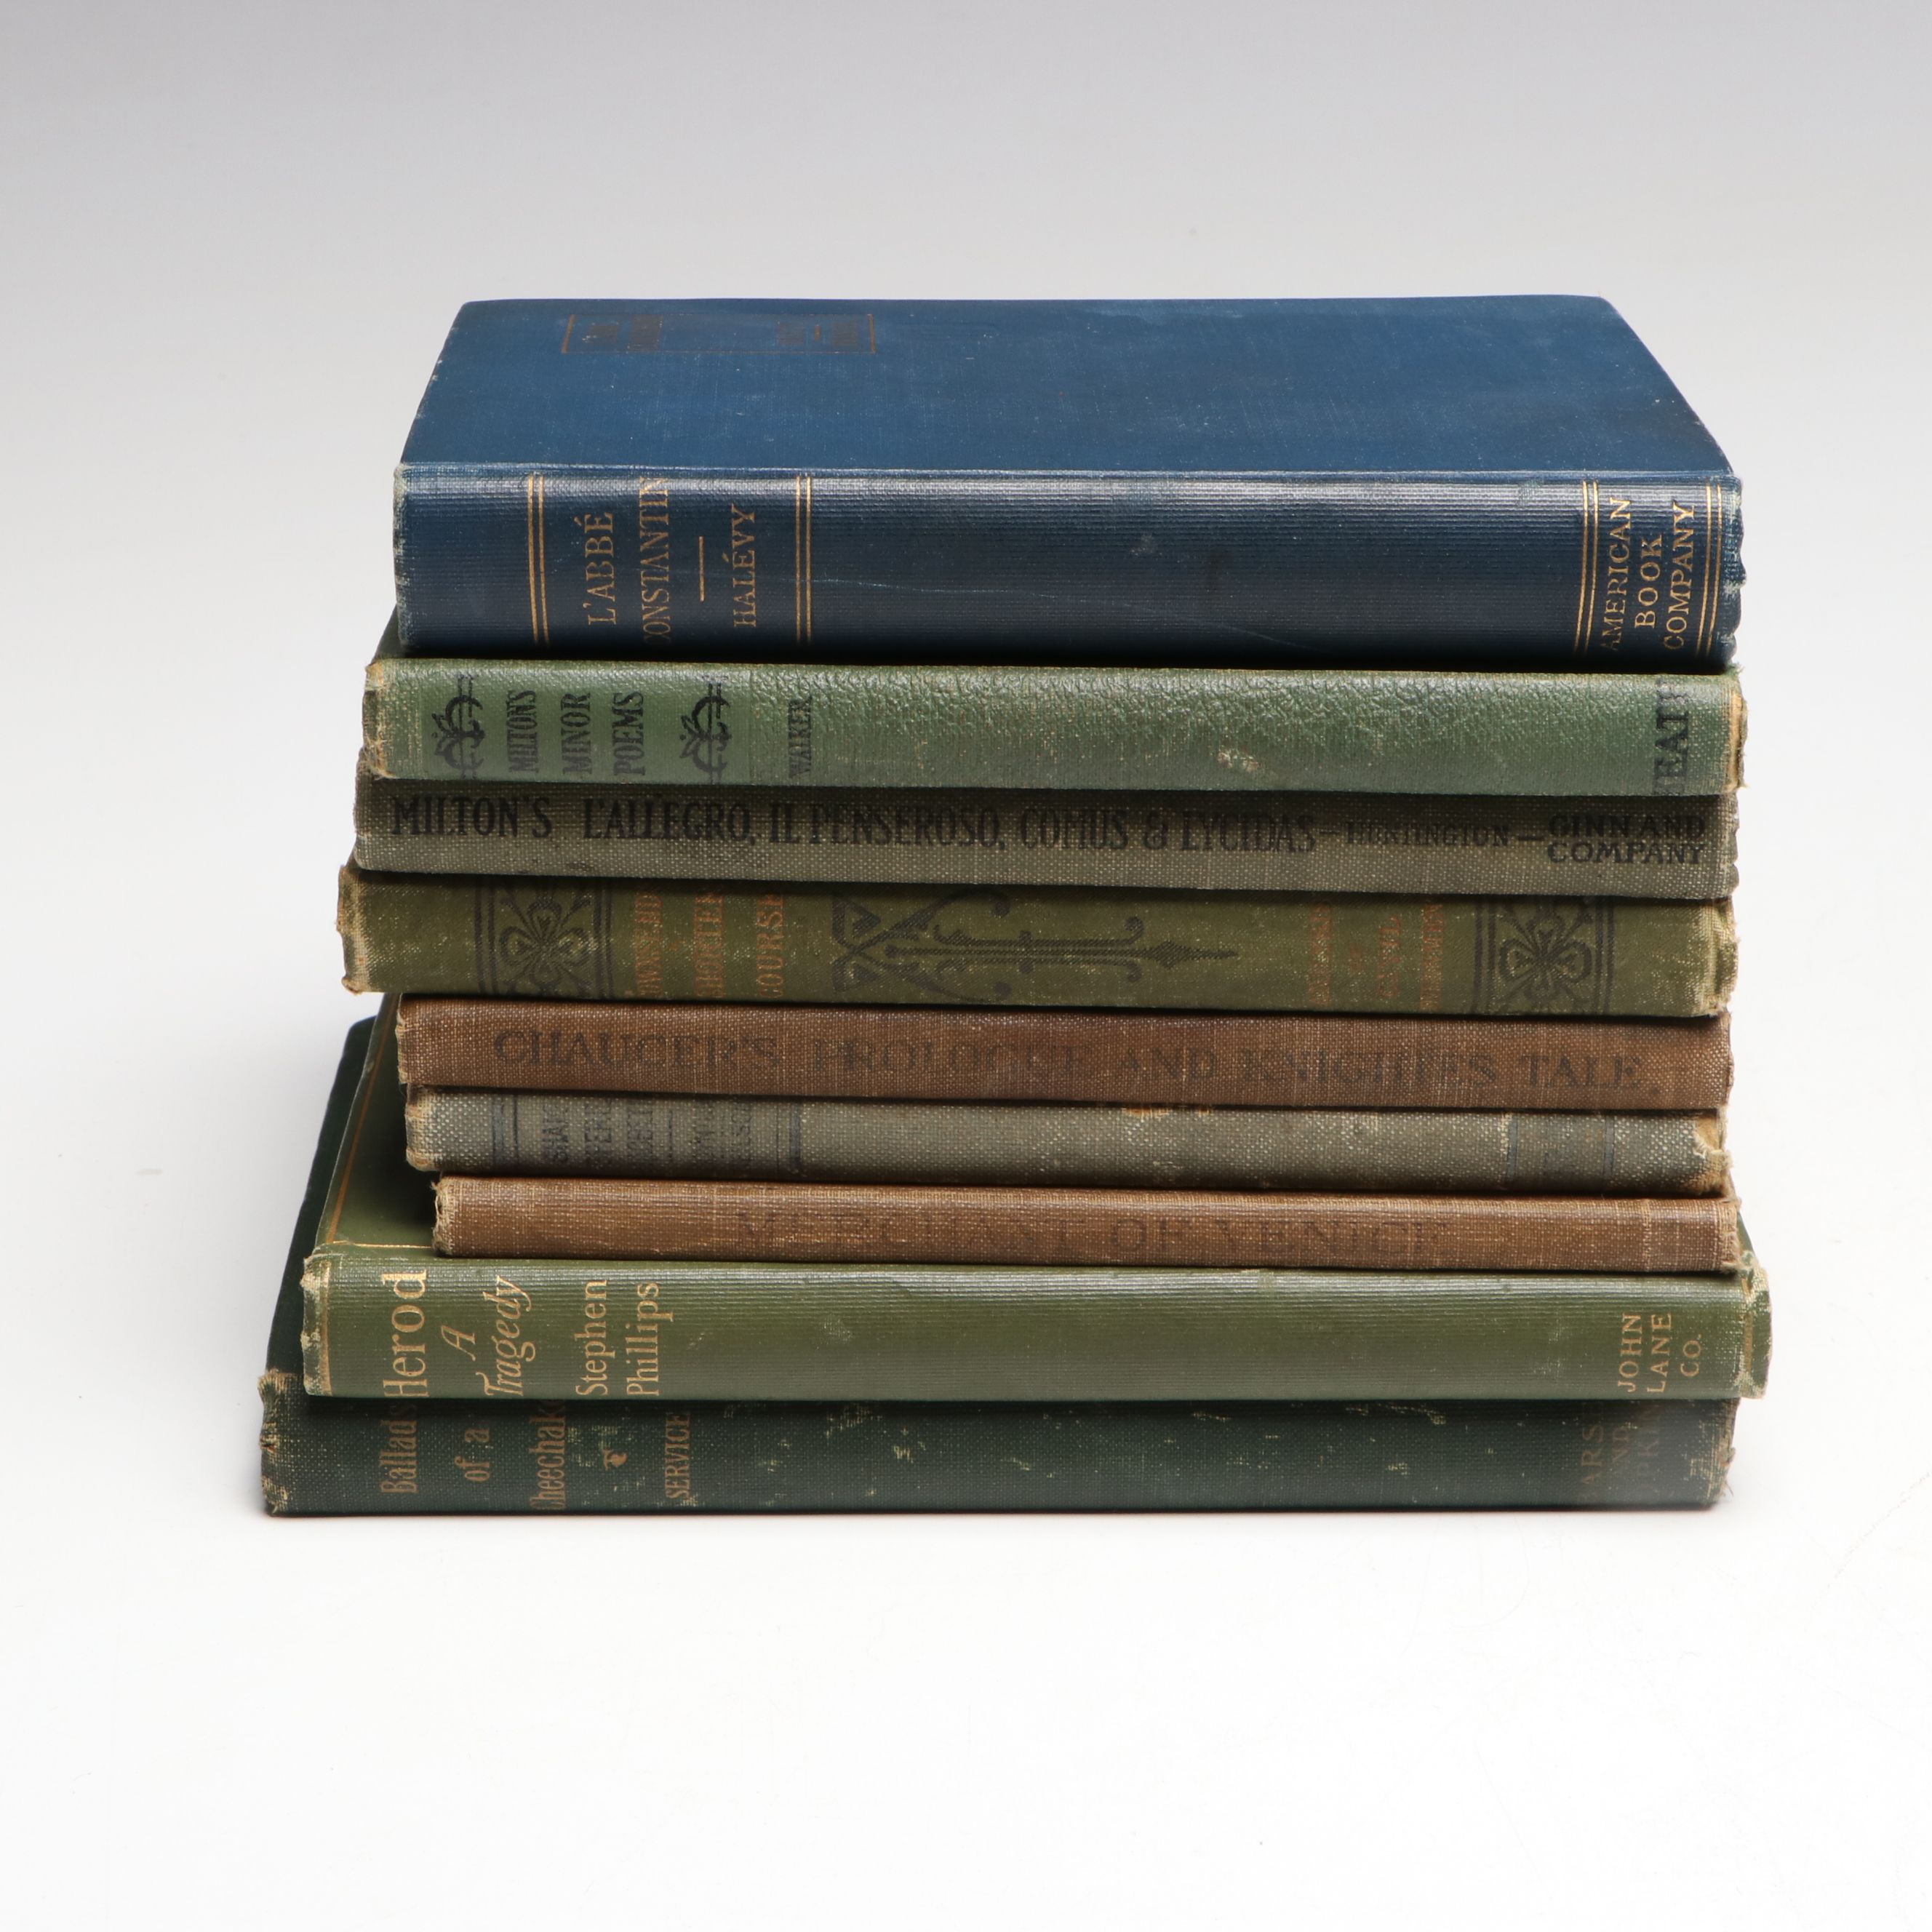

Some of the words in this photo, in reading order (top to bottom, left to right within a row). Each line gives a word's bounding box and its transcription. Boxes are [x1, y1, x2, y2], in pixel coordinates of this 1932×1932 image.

[575, 511, 617, 626] L'ABBÉ
[722, 503, 757, 628] HALÉVY
[1601, 497, 1632, 651] AMERICAN
[1634, 535, 1662, 628] BOOK
[1664, 500, 1695, 650] COMPANY
[561, 693, 593, 775] MINOR
[614, 691, 644, 776] POEMS
[789, 695, 813, 778] WALKER
[391, 797, 552, 839] MILTON'S
[1019, 807, 1127, 850] COMUS
[1144, 810, 1167, 850] &
[1547, 842, 1705, 865] COMPANY
[1548, 813, 1630, 837] GINN
[1640, 814, 1705, 838] AND
[382, 1269, 429, 1398] Herod
[441, 1324, 476, 1362] A
[476, 1275, 536, 1397] Tragedy
[575, 1279, 615, 1396] Stephen
[626, 1282, 673, 1396] Phillips
[1618, 1313, 1642, 1393] JOHN
[1647, 1313, 1671, 1393] LANE
[1680, 1334, 1702, 1378] CO.
[455, 1457, 490, 1482] of
[465, 1427, 490, 1443] a
[664, 1411, 690, 1499] SERVICE
